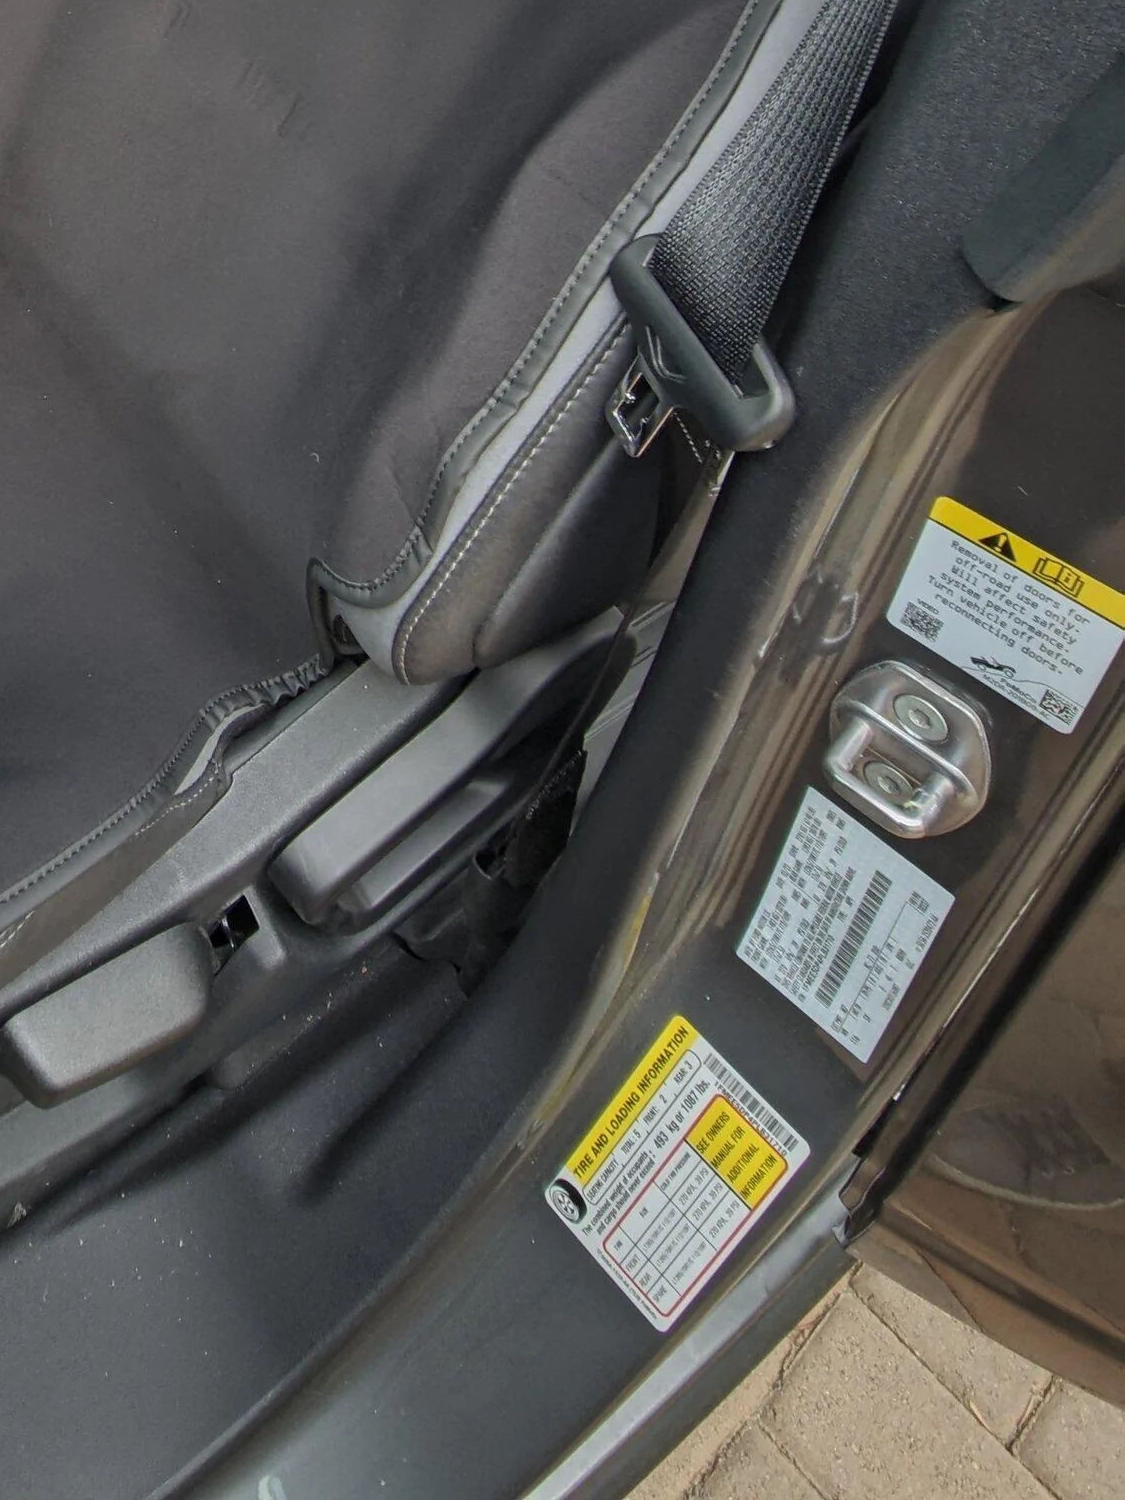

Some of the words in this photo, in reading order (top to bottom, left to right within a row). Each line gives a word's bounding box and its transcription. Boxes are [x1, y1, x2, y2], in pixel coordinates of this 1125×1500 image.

[938, 571, 982, 601] system
[948, 538, 1000, 573] Removal
[1001, 569, 1019, 585] of
[1022, 582, 1062, 610] doors
[1065, 606, 1092, 627] for
[949, 563, 979, 586] Will
[982, 584, 1028, 615] affect
[1029, 612, 1079, 647] safety
[954, 554, 1012, 593] off-road
[1015, 591, 1039, 610] use
[926, 574, 956, 597] Turn
[957, 594, 1008, 629] vehicle
[1010, 625, 1034, 644] off
[1037, 642, 1086, 675] before
[932, 592, 1017, 648] reconnecting
[572, 1151, 595, 1180] TIRE
[588, 1130, 610, 1158] AND
[604, 1089, 641, 1136] LOADING
[635, 1023, 690, 1095] INFORMATION
[651, 1129, 669, 1151] 493
[664, 1117, 681, 1136] kg
[673, 1110, 685, 1124] or
[679, 1088, 700, 1114] 1087
[693, 1075, 711, 1096] lbs.
[585, 1177, 604, 1201] SEATING
[599, 1157, 619, 1183] CAPACITY
[631, 1127, 642, 1139] 5
[657, 1092, 668, 1104] 2
[683, 1058, 694, 1071] 3
[694, 1136, 710, 1155] SEE
[704, 1110, 731, 1143] OWNERS
[709, 1137, 736, 1170] MANUAL
[729, 1124, 746, 1144] FOR
[620, 1174, 629, 1185] of
[624, 1149, 650, 1181] occupants
[724, 1140, 761, 1184] ADDITIONAL
[738, 1152, 778, 1201] INFORMATION
[588, 1197, 612, 1227] combined
[594, 1220, 607, 1235] and
[602, 1206, 619, 1227] cargo
[613, 1188, 631, 1211] should
[627, 1175, 642, 1194] never
[637, 1156, 656, 1180] exceed
[607, 1180, 626, 1204] weight
[581, 1222, 594, 1237] The
